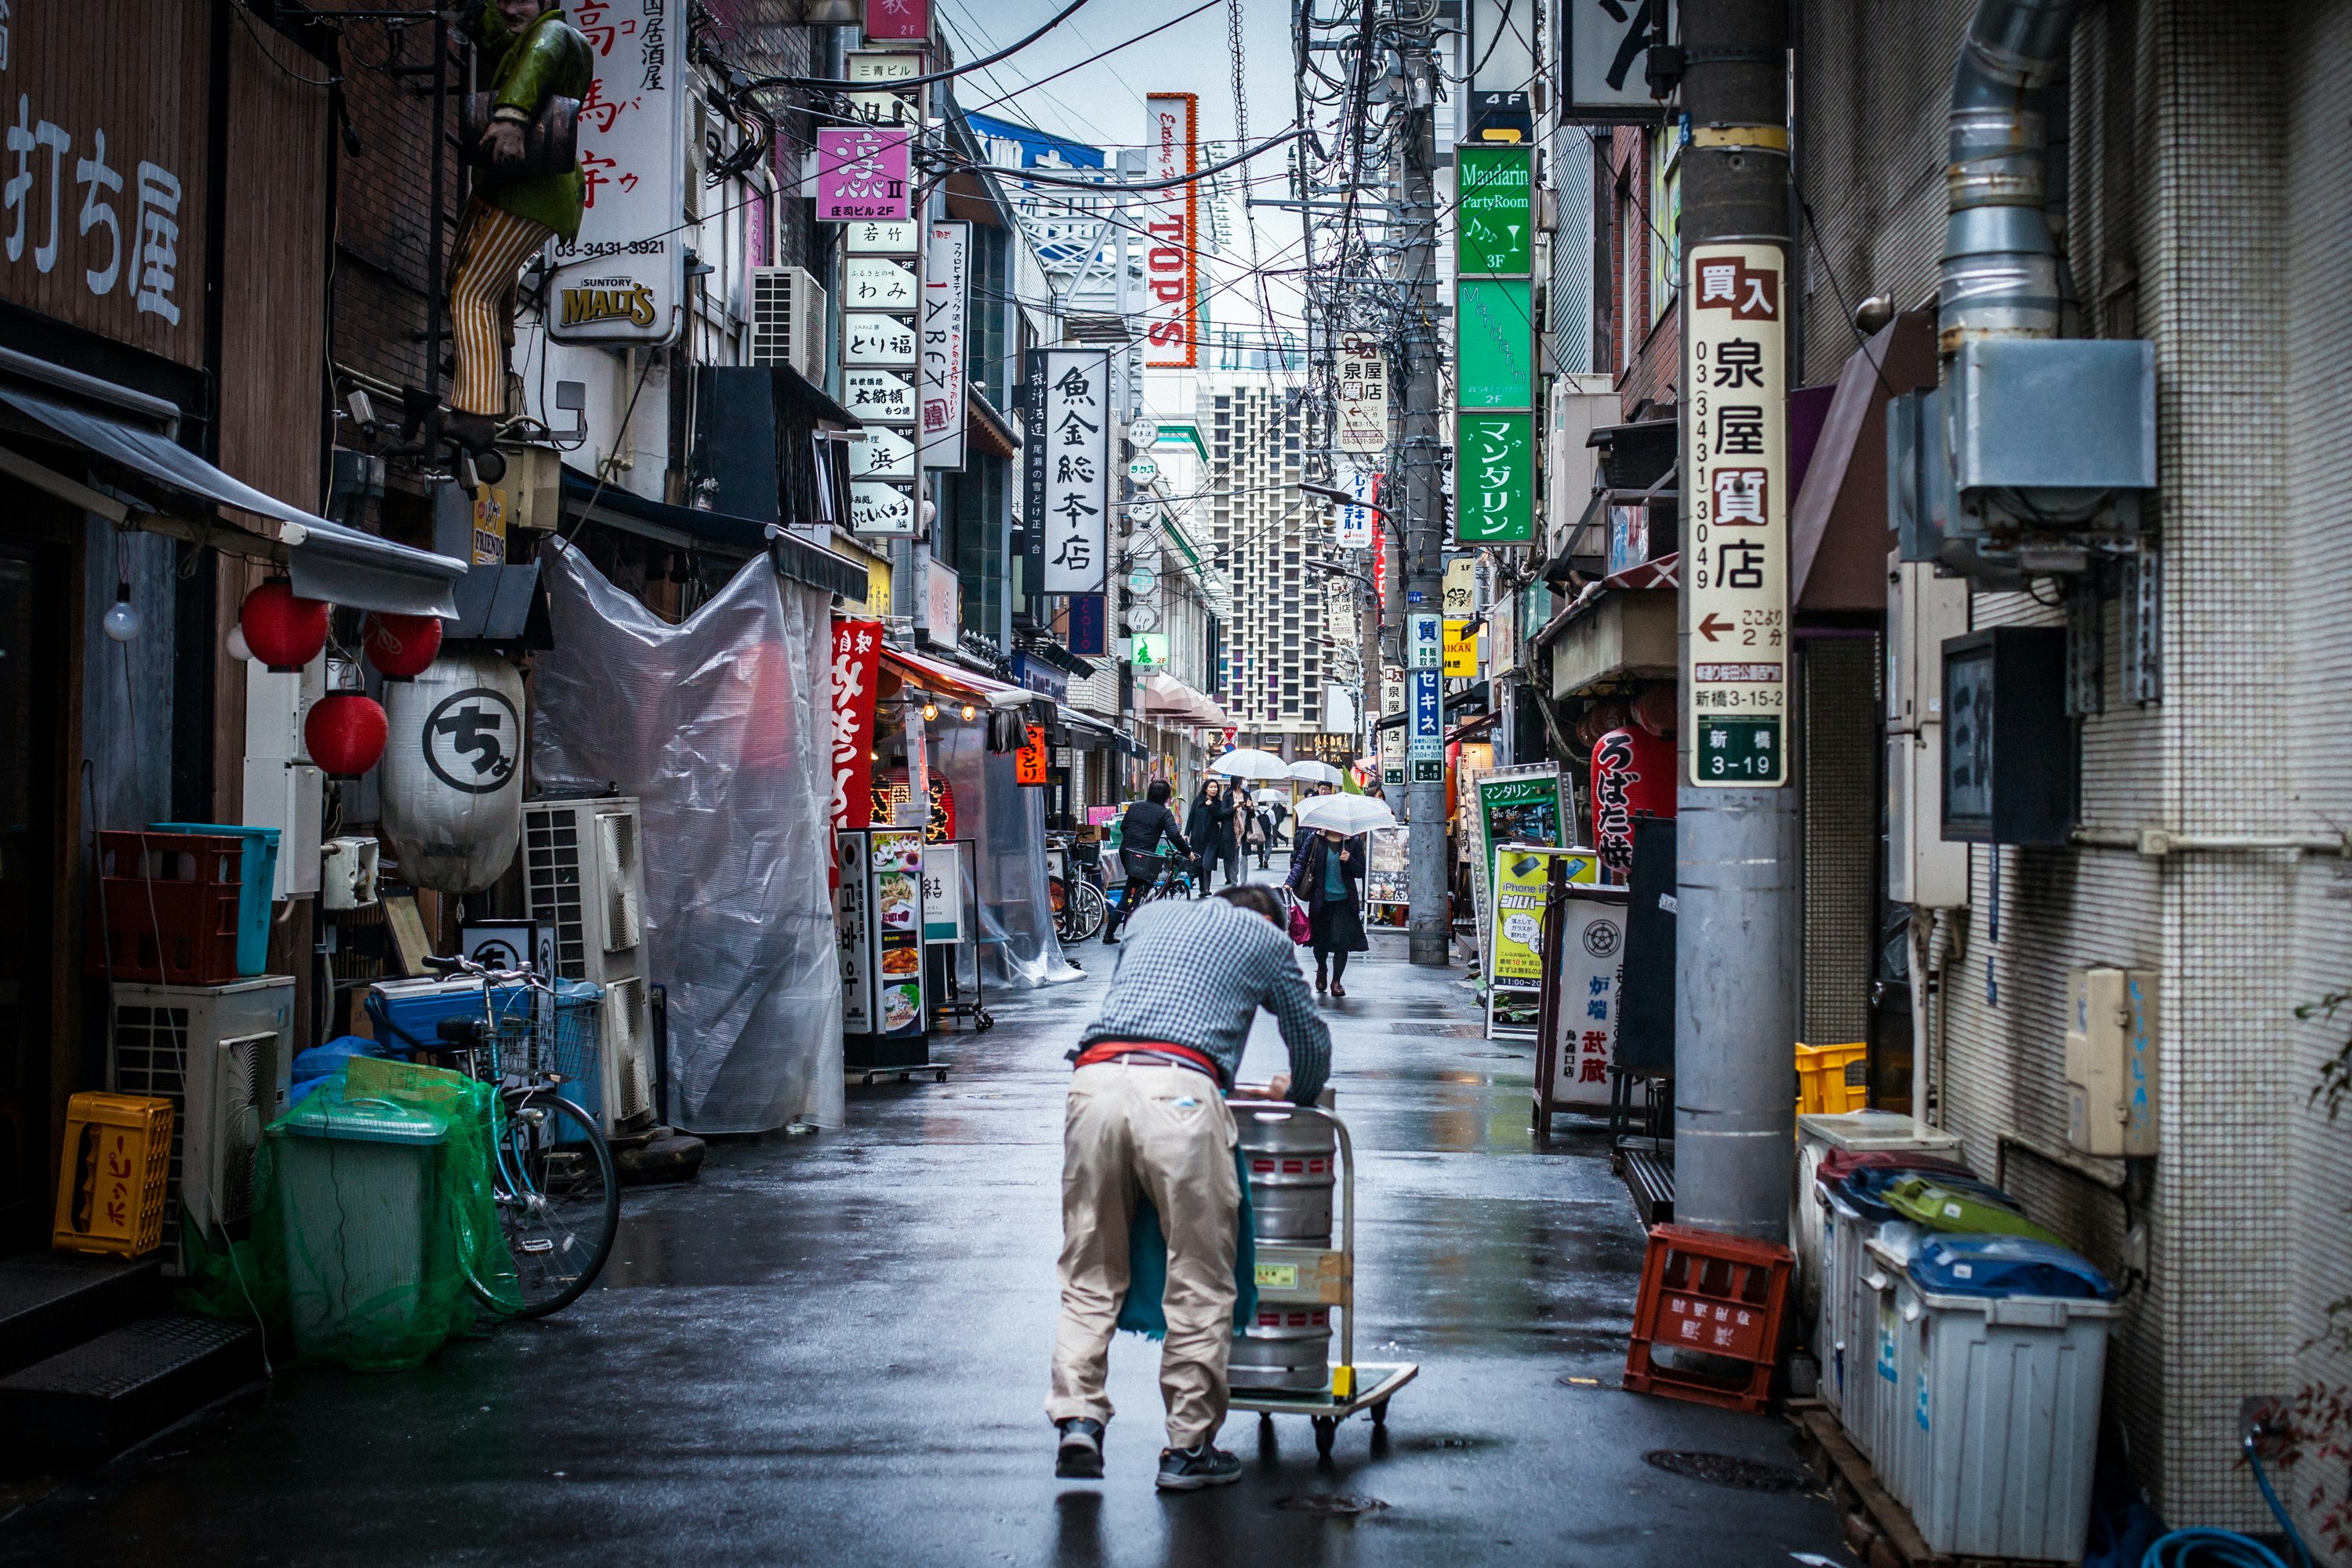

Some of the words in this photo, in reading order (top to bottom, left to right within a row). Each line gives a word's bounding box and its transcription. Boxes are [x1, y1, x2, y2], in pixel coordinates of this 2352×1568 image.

[902, 25, 915, 34] 2F
[860, 66, 910, 76] 三青ビル
[1486, 94, 1521, 104] 4F
[1462, 164, 1529, 186] Mandarin
[5, 93, 181, 325] 打ち屋
[831, 206, 874, 216] 庄司ビル
[877, 206, 895, 216] 2F
[863, 223, 902, 241] 若竹
[555, 241, 664, 257] 03-3431-3921
[1487, 255, 1505, 267] 3F
[583, 278, 632, 287] SUNTORY
[858, 281, 906, 299] わみ
[1702, 265, 1773, 314] 買入
[561, 283, 655, 325] MALT'S
[851, 335, 911, 354] とり福
[1344, 362, 1381, 379] 泉屋
[1344, 383, 1381, 401] 質店
[870, 448, 894, 469] 浜
[1051, 366, 1099, 570] 魚金総本店
[1714, 337, 1766, 588] 泉屋質店
[1131, 465, 1154, 474] ラクス
[1479, 422, 1512, 535] マンダリン
[1032, 445, 1042, 554] 尾瀬の雪どけ正一合
[475, 528, 504, 557] FRIENDS
[1081, 597, 1091, 649] COLO
[1743, 610, 1782, 626] ここより
[1418, 622, 1436, 641] 質
[1420, 671, 1436, 733] セキネ
[1696, 691, 1783, 707] 新橋3-15-2
[1388, 686, 1399, 742] 泉屋店
[1710, 731, 1771, 750] 新橋
[1711, 756, 1769, 775] 3-19
[1483, 784, 1530, 800] マンダリン
[1503, 883, 1536, 893] iPhone
[841, 882, 858, 996] 고바우
[1587, 975, 1610, 1020] 炉端
[1578, 1031, 1607, 1084] 武蔵
[103, 1136, 132, 1227] ホッピー
